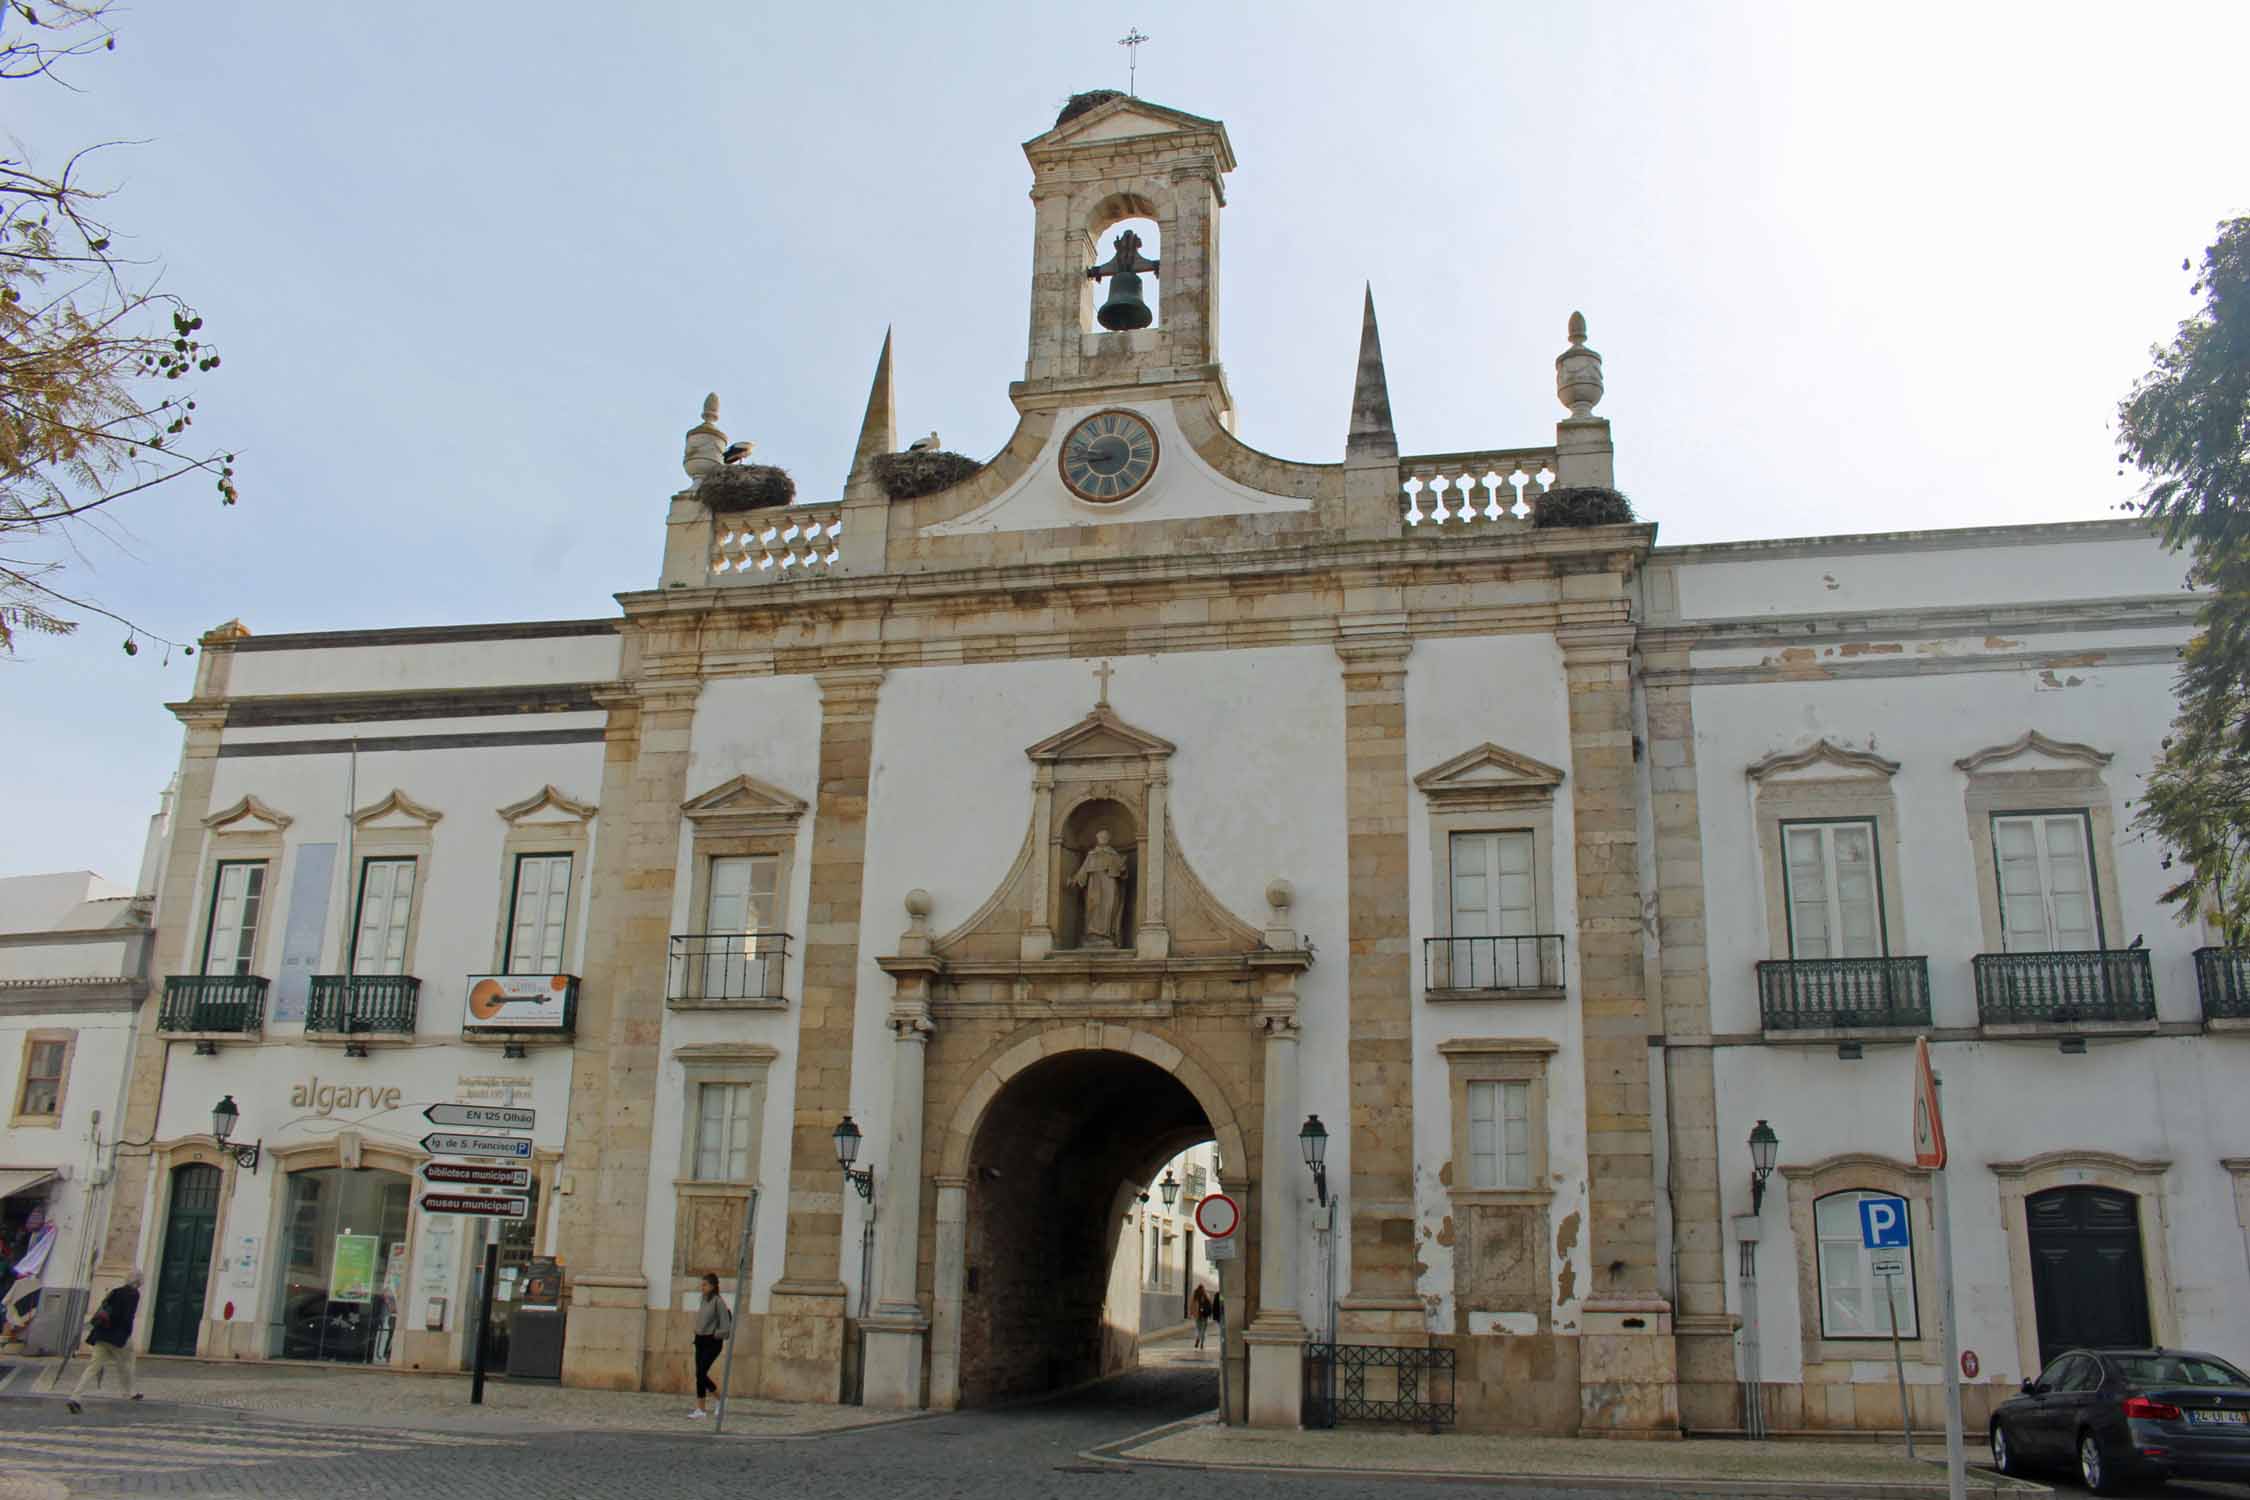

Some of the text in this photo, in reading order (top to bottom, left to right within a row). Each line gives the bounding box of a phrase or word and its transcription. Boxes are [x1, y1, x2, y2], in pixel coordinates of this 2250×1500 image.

[291, 1076, 402, 1116] algarve
[466, 1110, 532, 1122] EN 125 Olhão
[446, 1137, 458, 1148] de
[460, 1140, 469, 1148] S.
[473, 1140, 515, 1151] Francisco
[518, 1143, 527, 1154] P
[428, 1167, 514, 1181] biblioteca municipal
[425, 1199, 511, 1212] museu municipal
[1868, 1203, 1896, 1245] P
